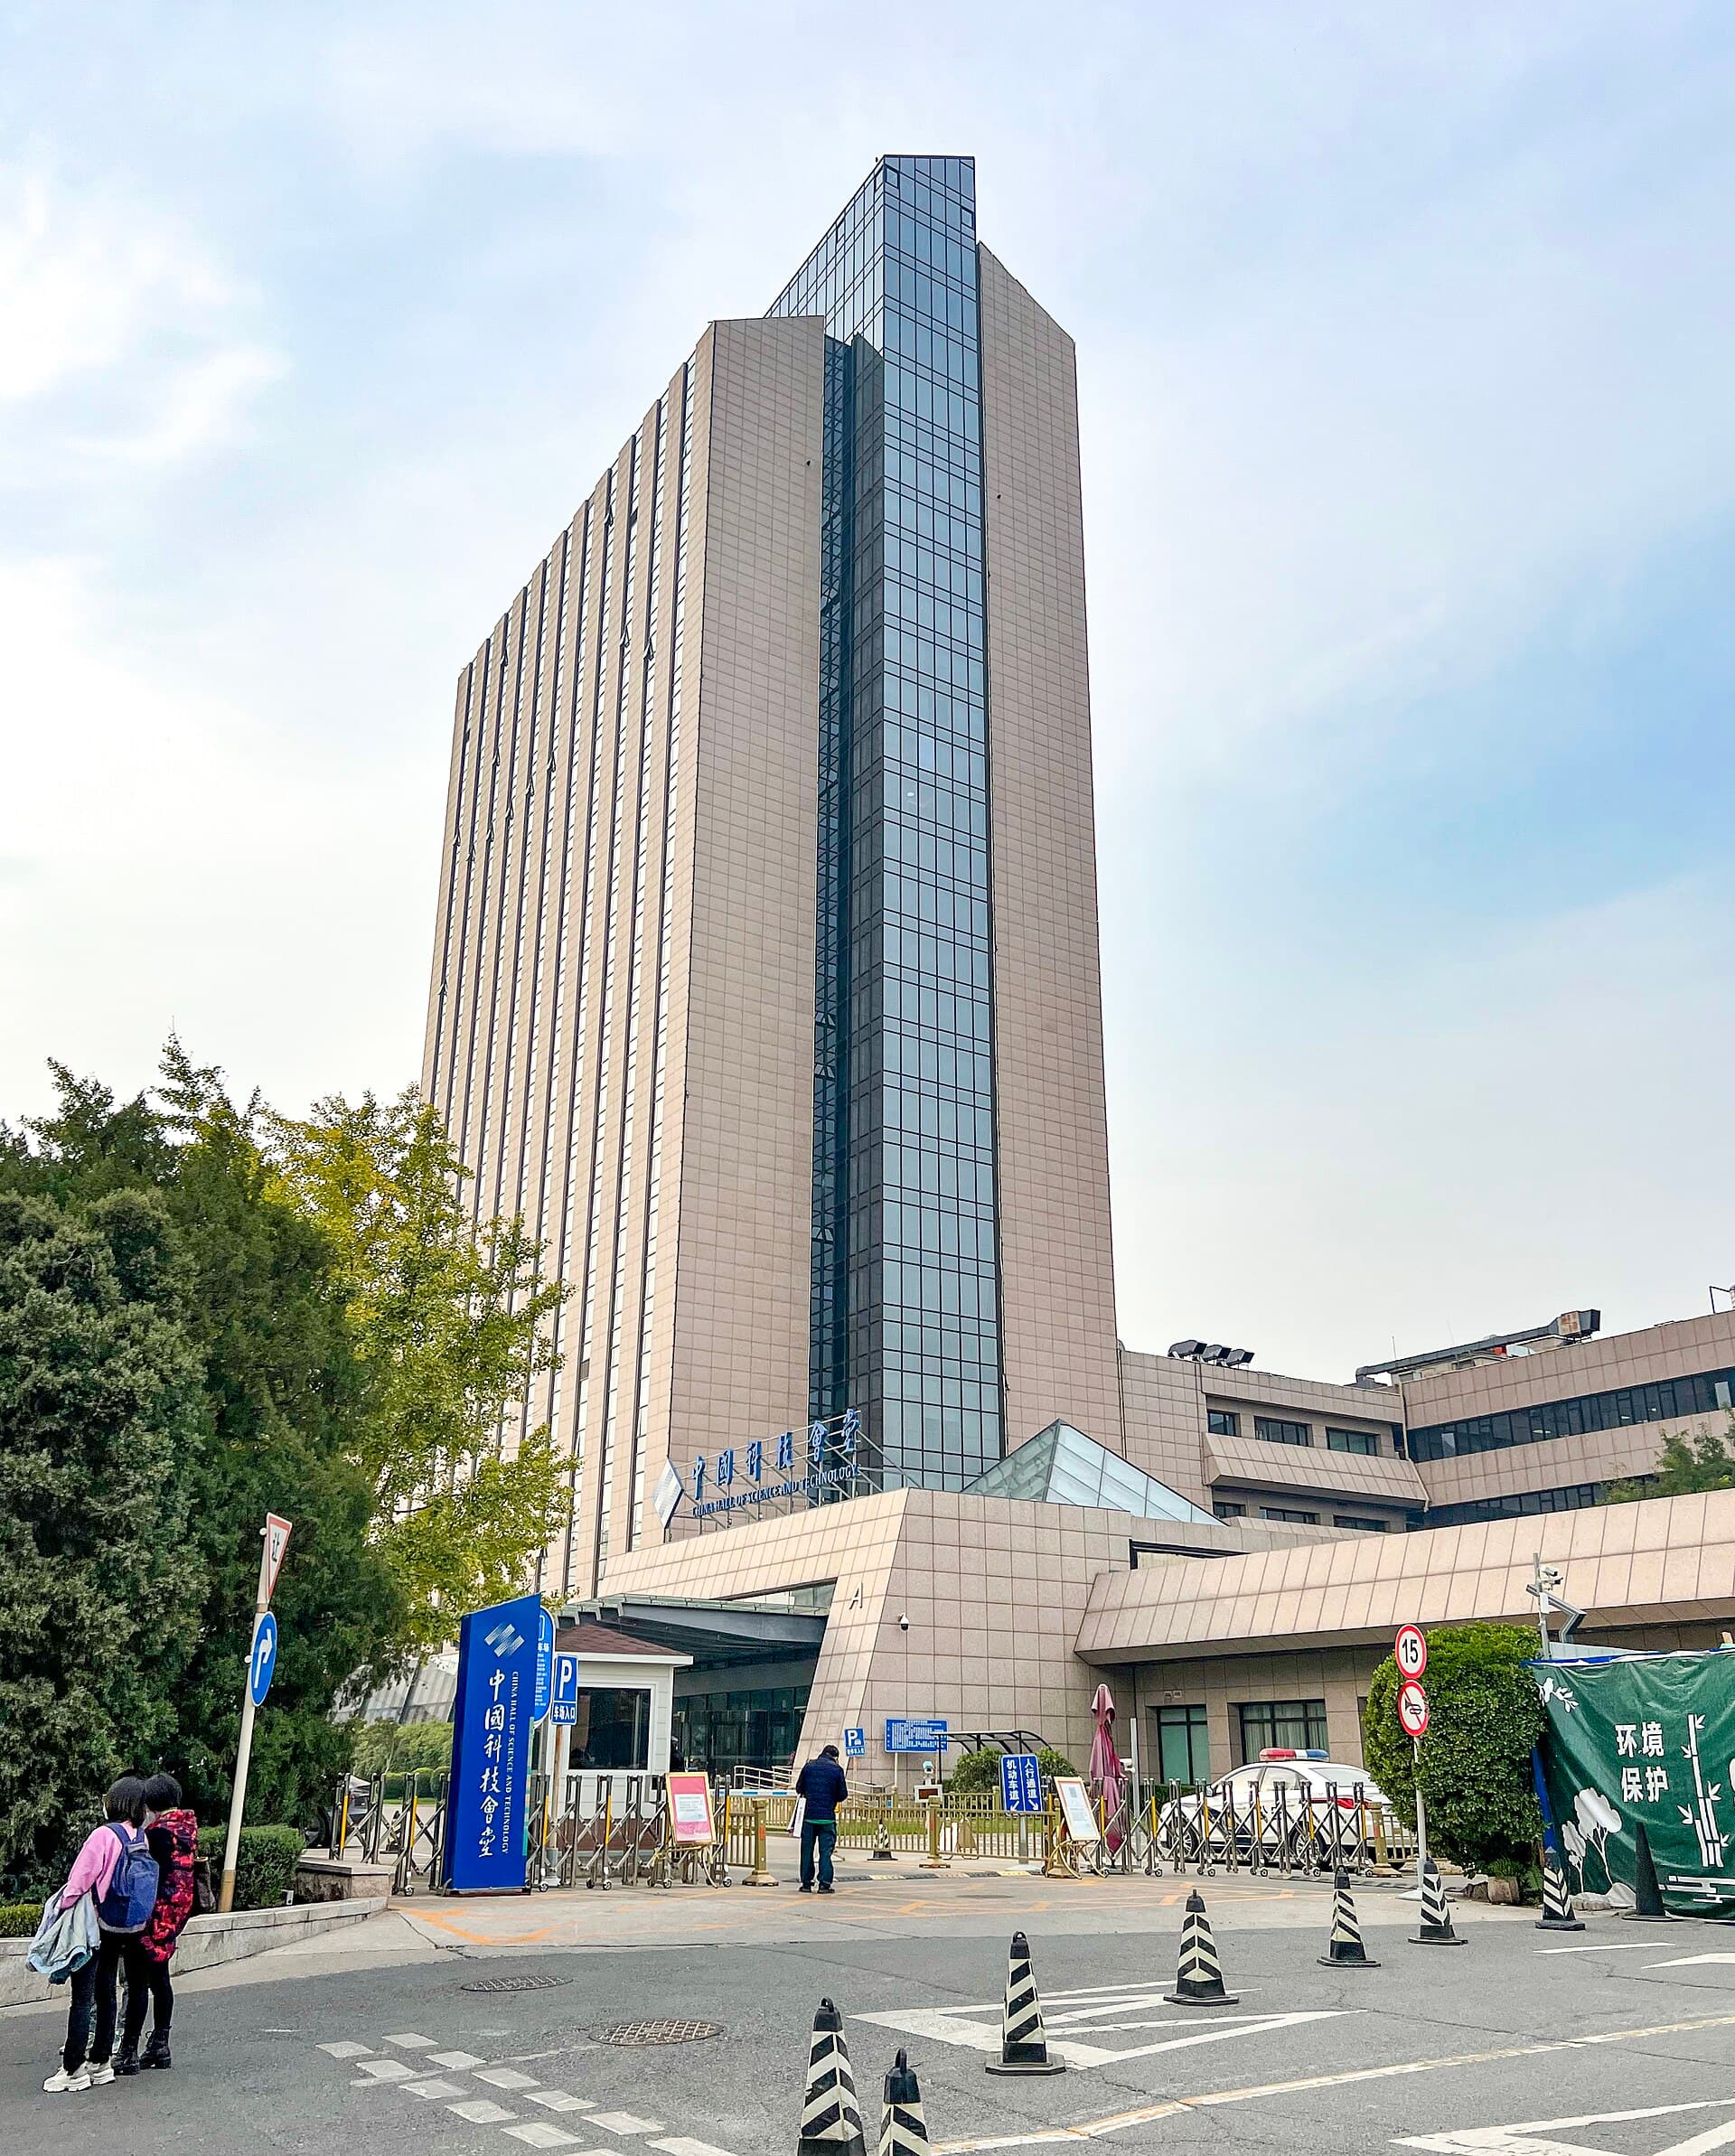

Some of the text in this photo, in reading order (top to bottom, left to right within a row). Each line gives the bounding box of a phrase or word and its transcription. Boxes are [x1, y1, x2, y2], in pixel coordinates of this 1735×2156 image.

[692, 1464, 861, 1517] CHINA HALL OF SCIENCE AND TECHNOLOGY
[849, 1582, 863, 1610] A
[1402, 1638, 1419, 1664] 15
[558, 1659, 573, 1699] P
[554, 1705, 576, 1720] 车场入口
[847, 1729, 858, 1747] P
[1615, 1720, 1665, 1758] 环境
[502, 1671, 520, 1854] CHINA HALL OF SCIENCE AND TECHNOLOGY
[1006, 1759, 1020, 1801] 机动车道
[1024, 1758, 1038, 1799] 人行通道
[1621, 1766, 1669, 1803] 保护
